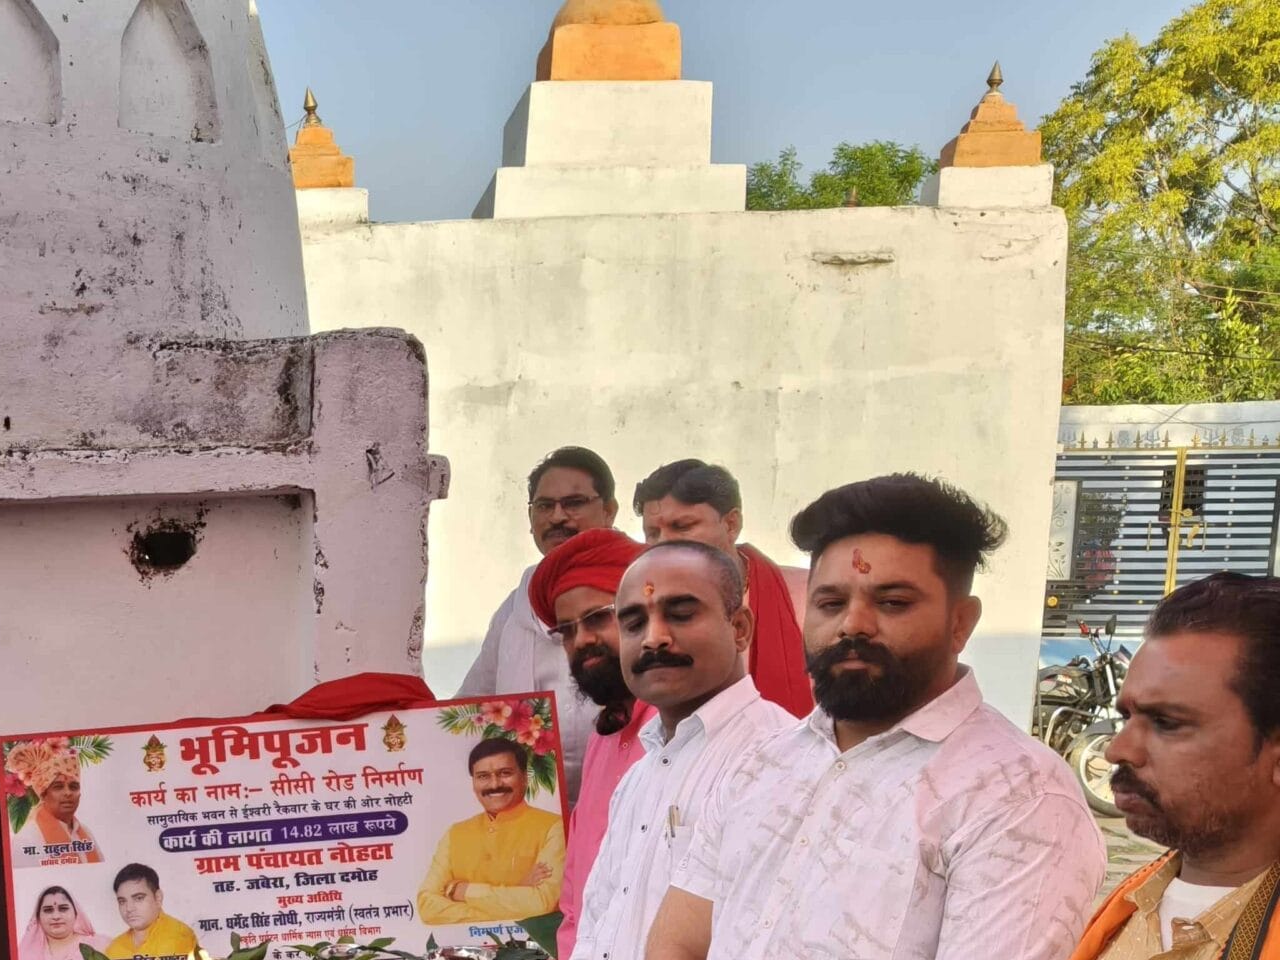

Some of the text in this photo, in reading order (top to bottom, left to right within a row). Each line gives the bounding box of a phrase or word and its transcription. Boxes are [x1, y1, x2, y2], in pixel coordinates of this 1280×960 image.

[179, 722, 369, 776] भूमिपूजन
[130, 782, 167, 807] कार्य
[174, 787, 198, 804] का
[270, 771, 315, 796] सीसी
[322, 770, 357, 792] रोड
[362, 762, 424, 790] निर्माण
[147, 810, 198, 828] सामुदायिक
[202, 810, 225, 821] भवन
[229, 806, 238, 819] से
[311, 799, 321, 812] के
[324, 801, 340, 811] घर
[344, 796, 357, 809] की
[361, 795, 381, 808] ओर
[162, 830, 196, 849] कार्य
[200, 829, 222, 846] की
[227, 828, 273, 844] लागत
[280, 824, 322, 839] 14.82
[327, 820, 359, 834] लाख
[43, 843, 70, 857] राहुल
[72, 840, 93, 852] सिंह
[194, 842, 393, 875] ग्राम पंचायत नोहटा
[294, 872, 336, 887] जिला
[338, 868, 379, 883] दमोह
[276, 890, 343, 908] मुख्य अतिथि
[250, 912, 270, 928] सिंह
[304, 905, 345, 923] राज्यमंत्री
[272, 949, 282, 960] के
[285, 951, 301, 959] कर
